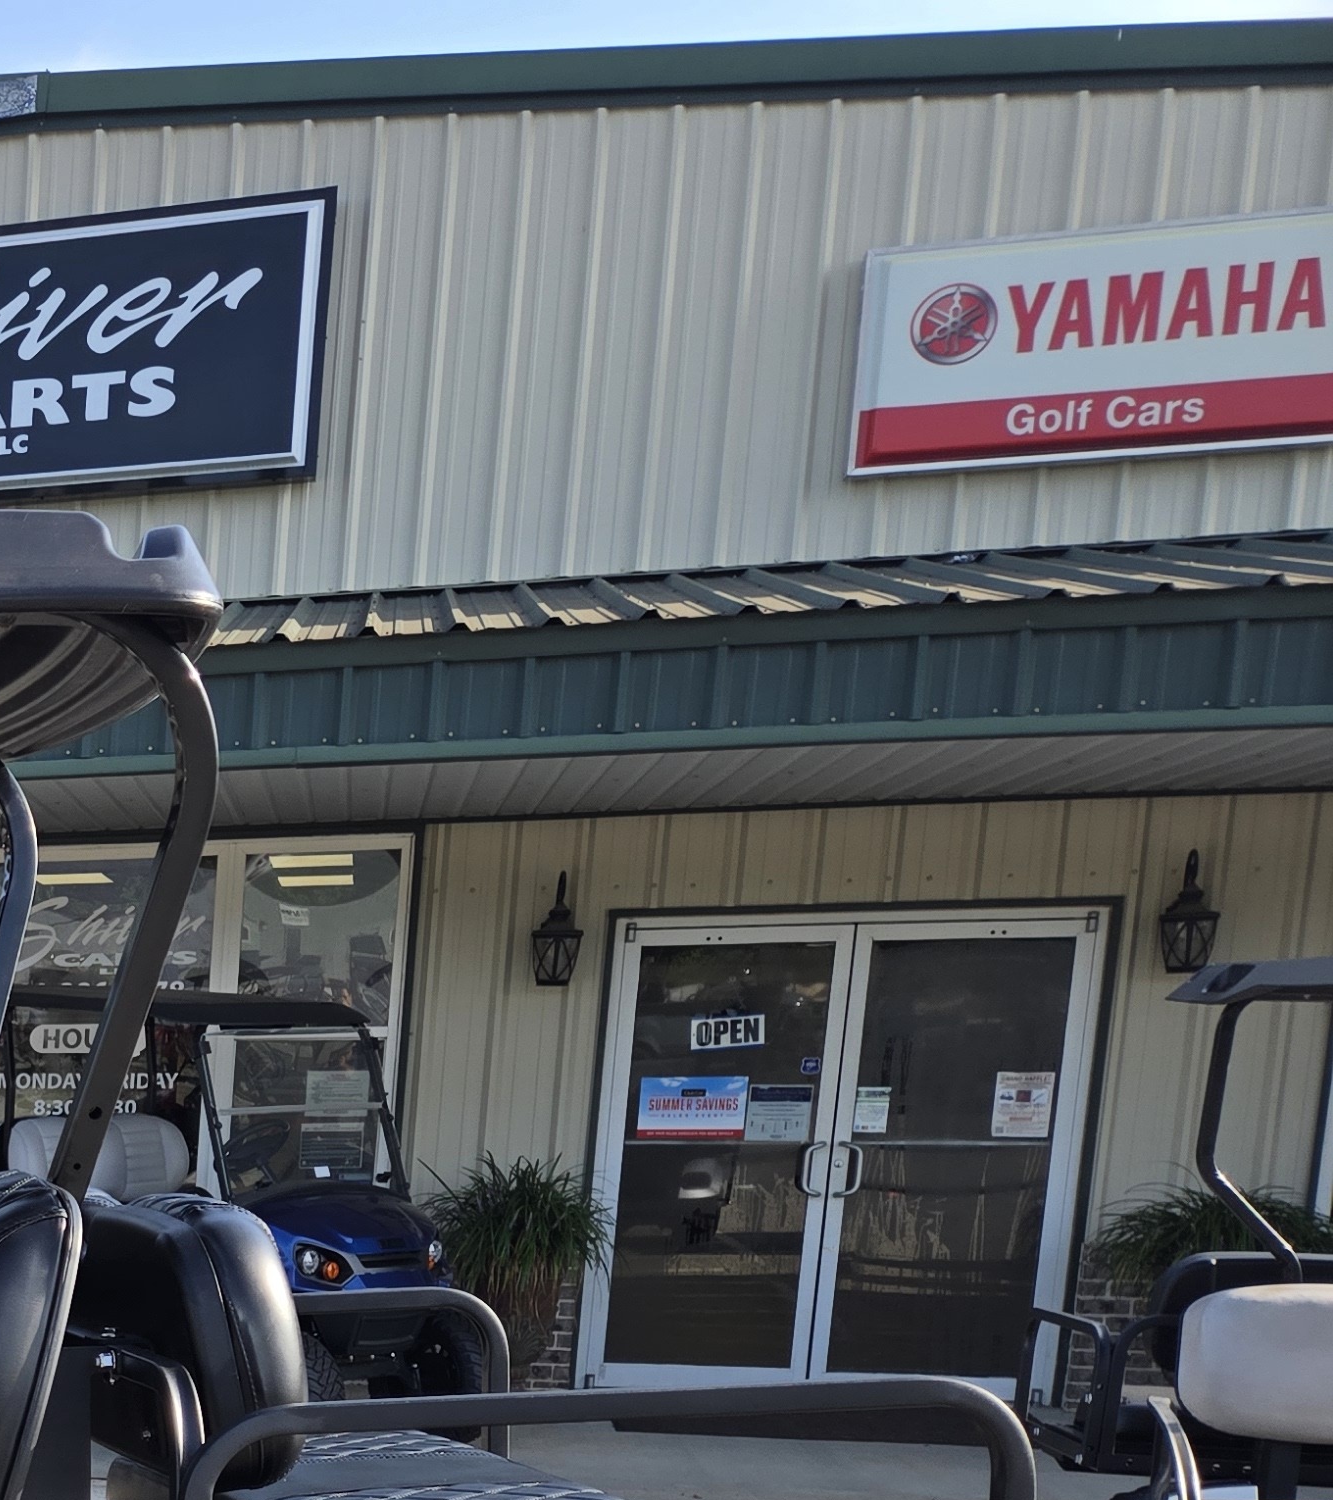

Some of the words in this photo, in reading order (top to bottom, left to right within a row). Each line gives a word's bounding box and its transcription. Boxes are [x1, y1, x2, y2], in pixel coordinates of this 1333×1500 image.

[1008, 257, 1326, 353] YAMAHA
[1006, 400, 1093, 436] Golf
[1106, 396, 1204, 429] Cars
[695, 1017, 760, 1047] OPEN
[648, 1098, 693, 1111] SUMMER
[695, 1098, 739, 1111] SAVINGS
